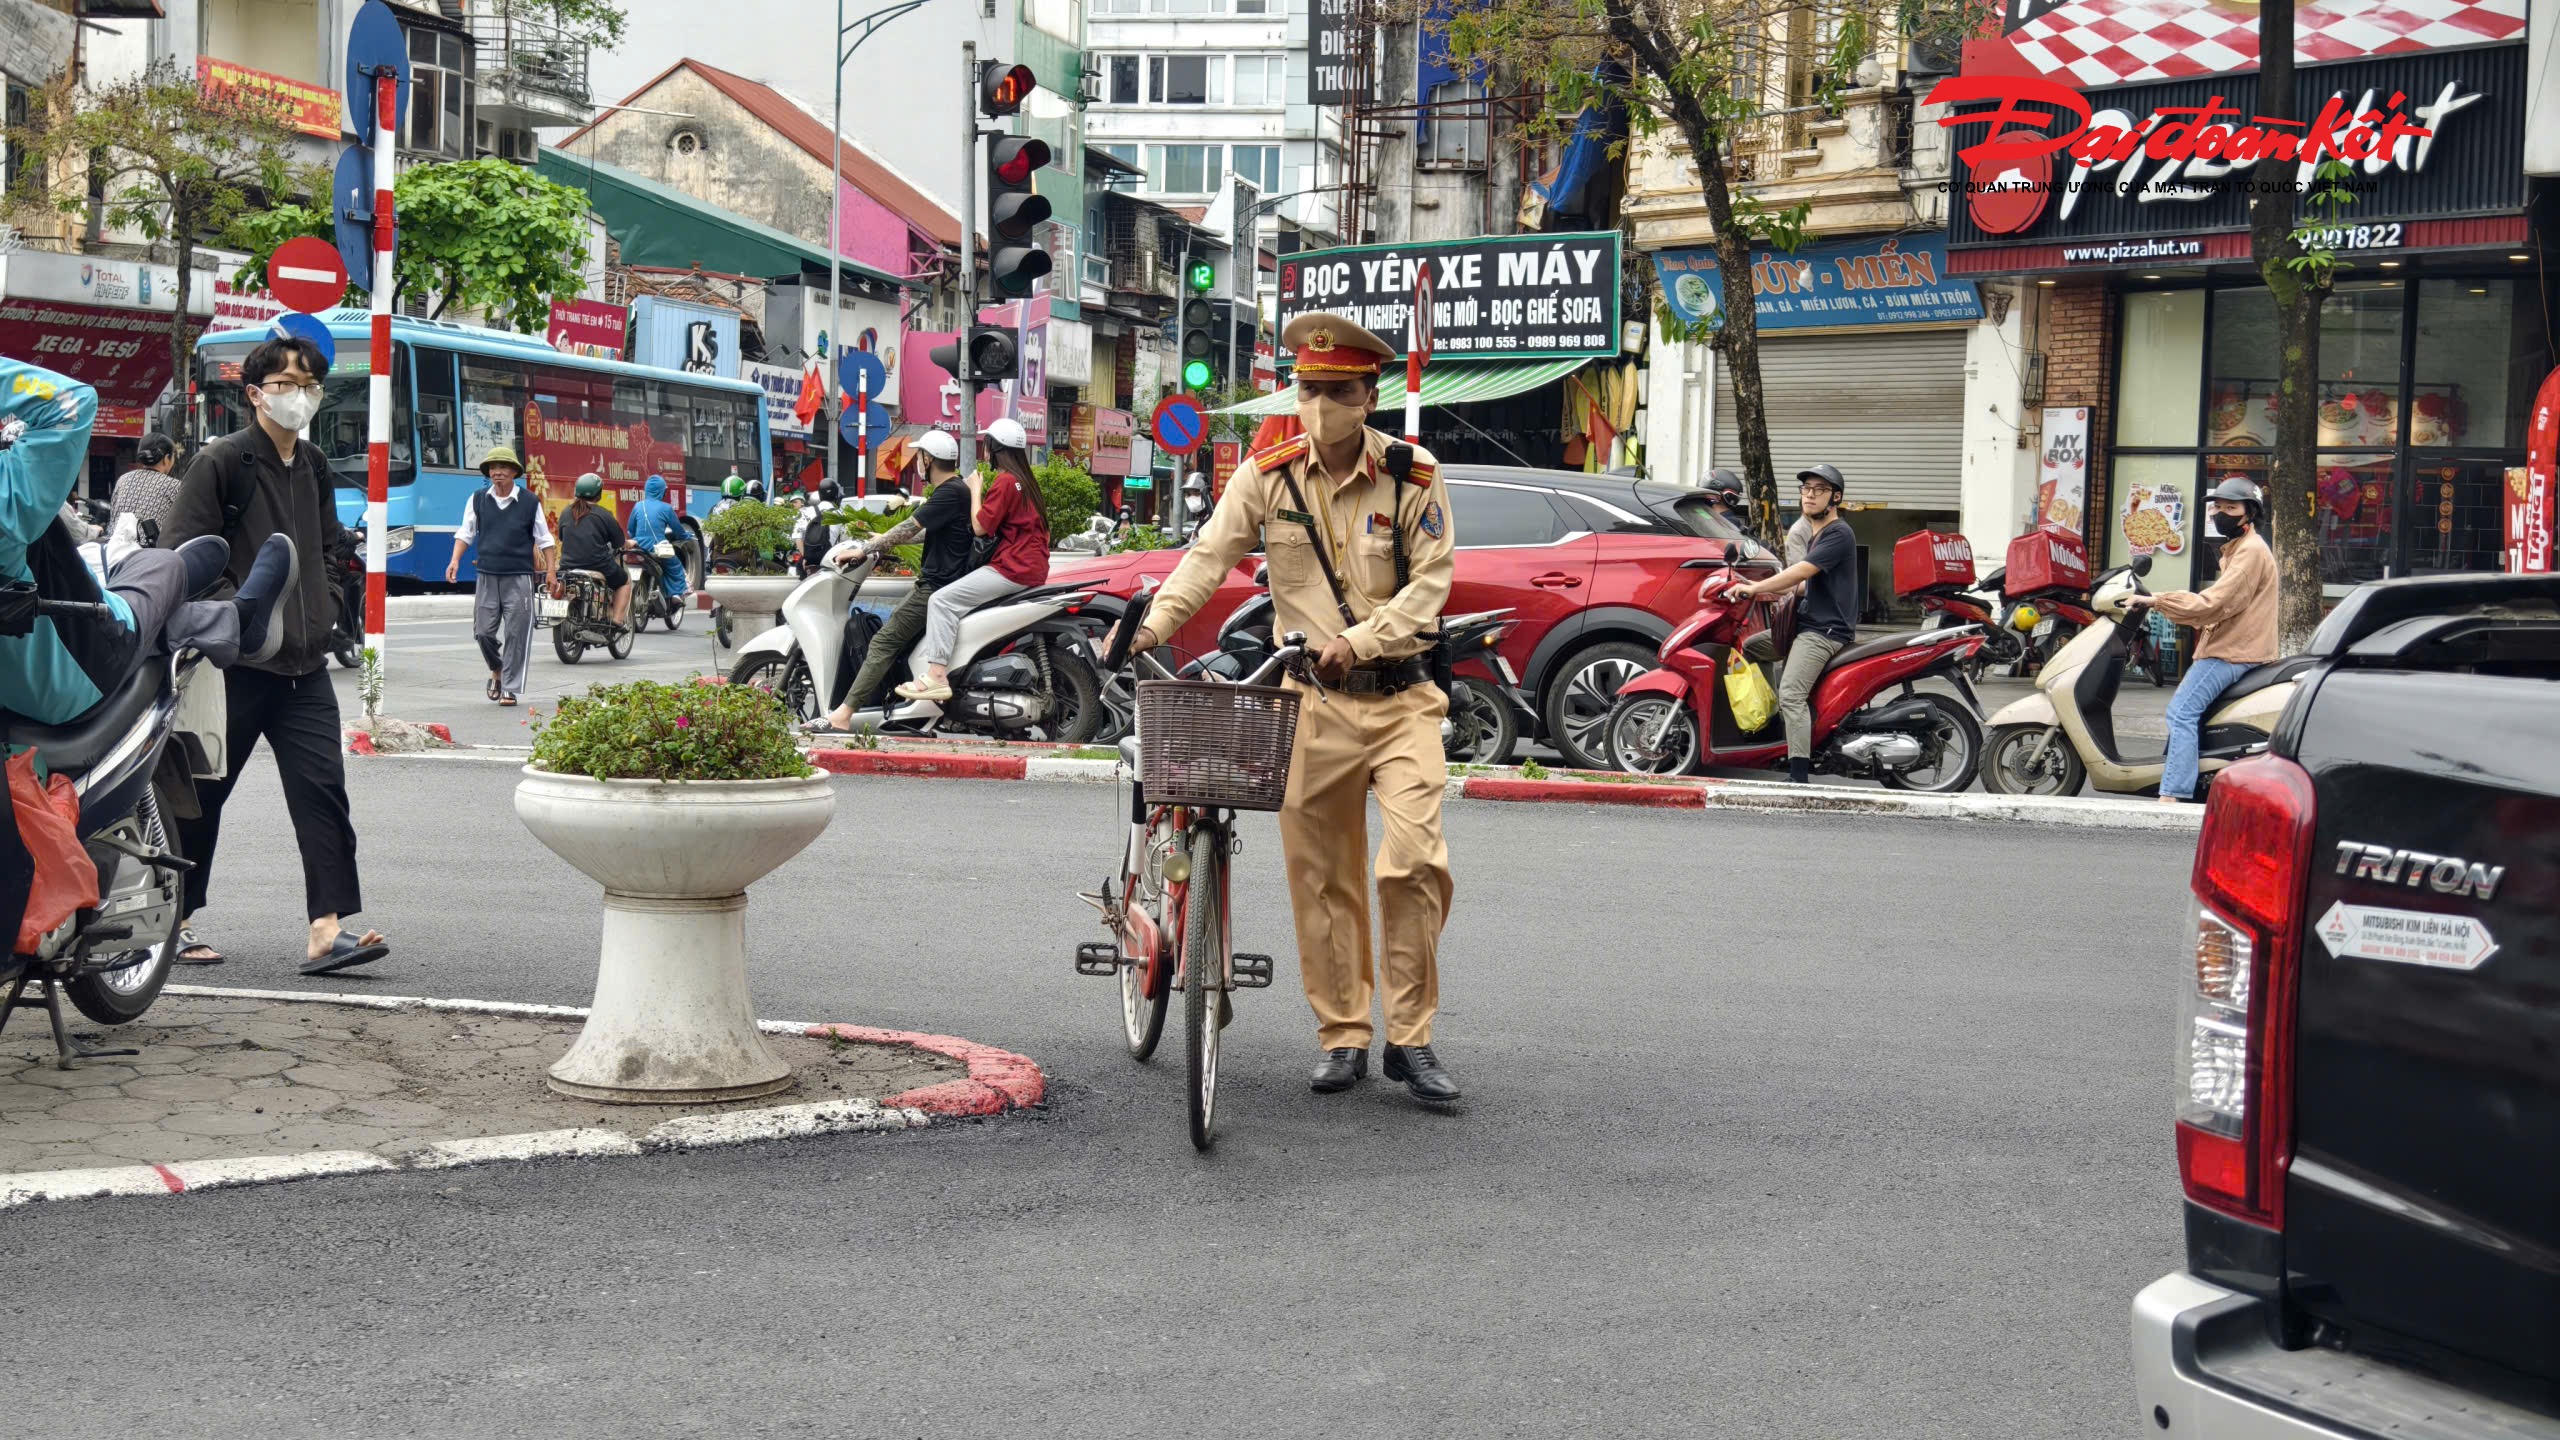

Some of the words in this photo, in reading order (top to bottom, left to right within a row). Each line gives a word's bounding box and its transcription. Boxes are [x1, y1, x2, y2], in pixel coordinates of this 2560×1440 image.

[2064, 240, 2200, 264] www.pizzahut.vn
[1193, 264, 1210, 285] 12
[1303, 262, 1350, 304] BỌC
[1361, 252, 1428, 293] YÊN
[1437, 254, 1482, 290] XE
[1498, 243, 1601, 287] MÁY
[1835, 239, 1938, 291] MIẾN
[1491, 299, 1523, 331] BỌC
[1527, 290, 1557, 326] GHẾ
[1562, 296, 1602, 325] SOFA
[33, 335, 61, 352] XE
[58, 336, 84, 354] GA
[1433, 338, 1448, 349] Tel:
[1451, 337, 1472, 349] 0983
[1475, 337, 1493, 348] 100
[1495, 336, 1517, 348] 555
[1527, 335, 1556, 347] 0989
[1559, 334, 1581, 347] 969
[1583, 334, 1606, 346] 808
[2053, 435, 2081, 448] MY
[2048, 449, 2084, 462] BOX
[2335, 839, 2505, 900] TRITON
[2362, 914, 2404, 932] MITSUBISHI
[2406, 920, 2421, 932] KIM
[2422, 918, 2439, 935] LIÊN
[2454, 922, 2471, 940] NỘI
